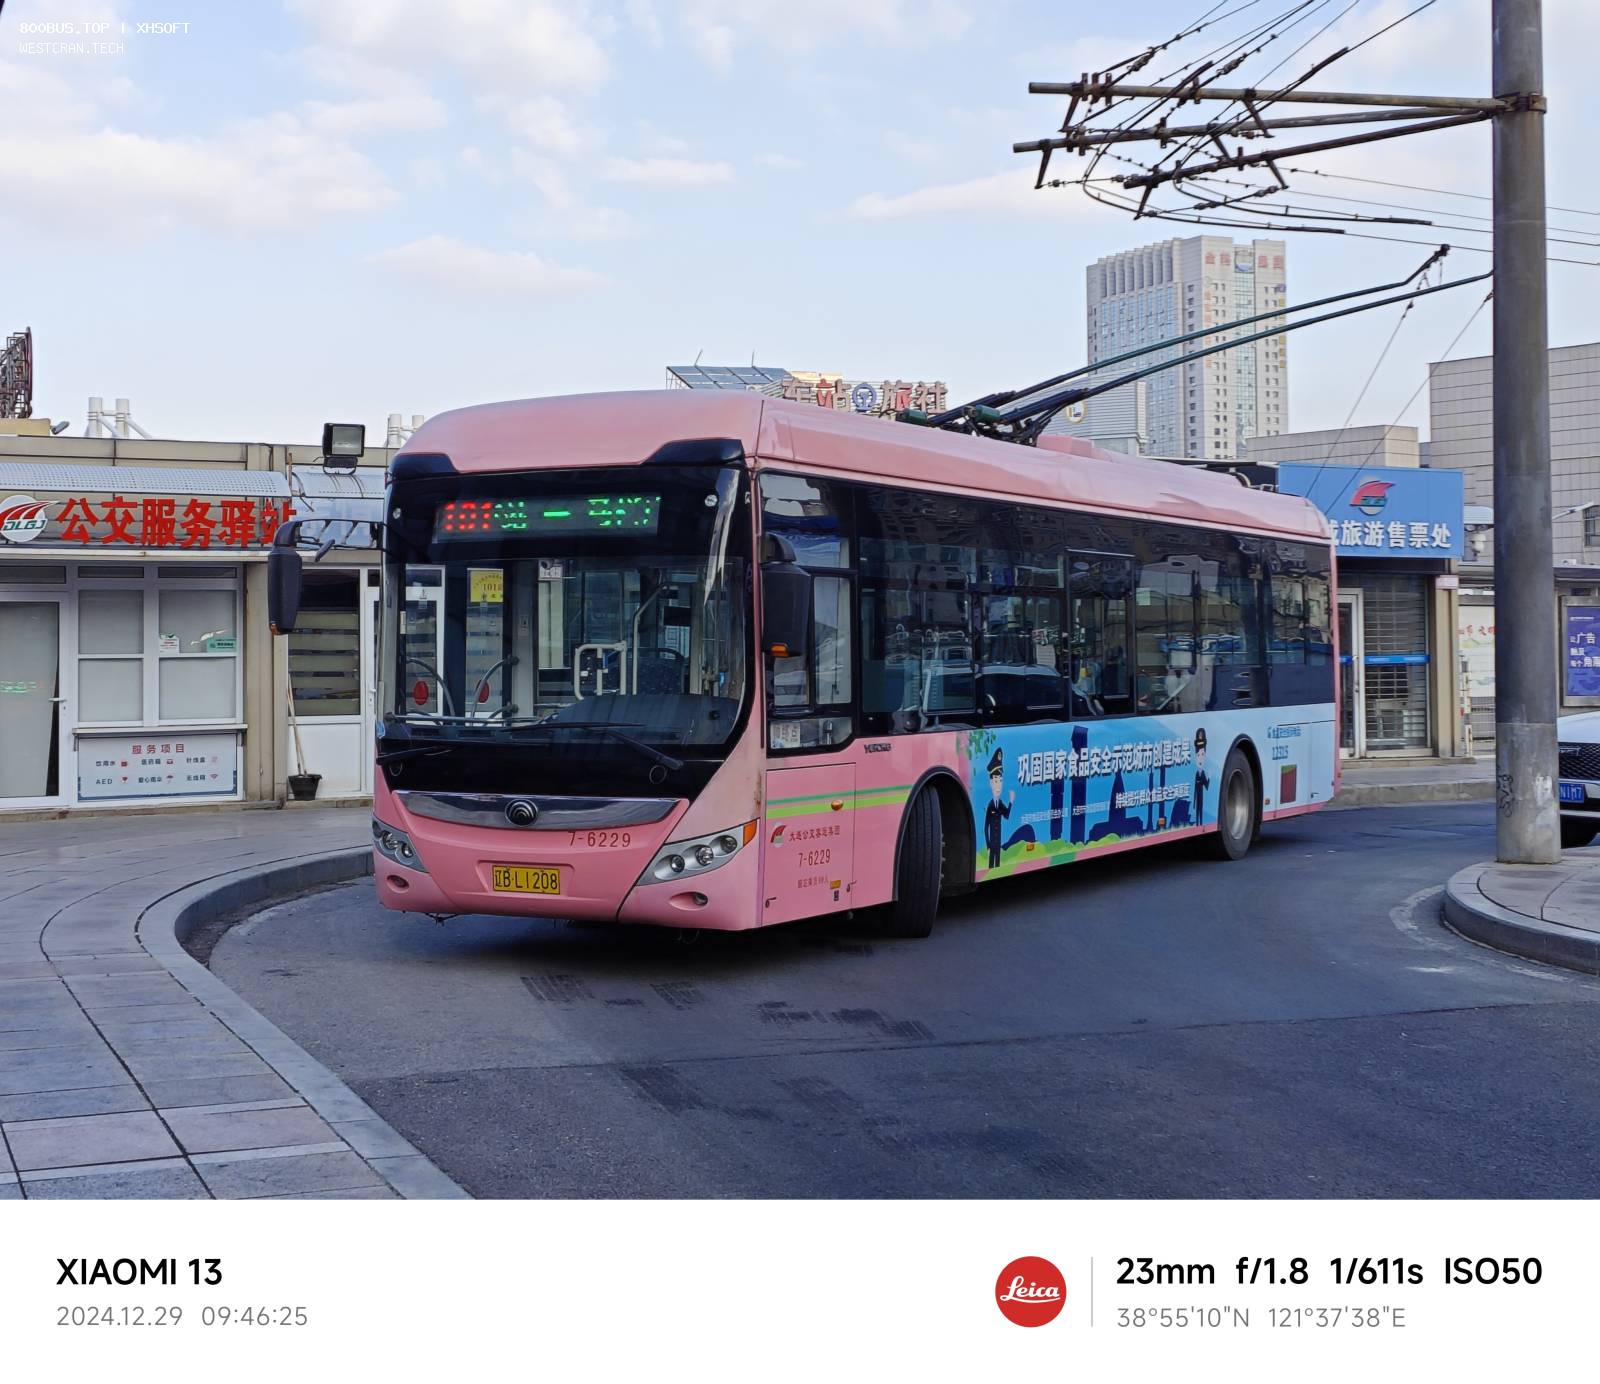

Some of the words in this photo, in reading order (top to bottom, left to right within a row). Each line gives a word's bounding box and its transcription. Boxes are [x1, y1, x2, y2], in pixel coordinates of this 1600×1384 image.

[880, 379, 949, 415] 旅社
[132, 744, 185, 755] 服务项目
[1018, 739, 1191, 785] 巩固国家食品安全示范城市创建成果
[568, 831, 631, 848] 7-6229
[798, 848, 831, 868] 7-6229
